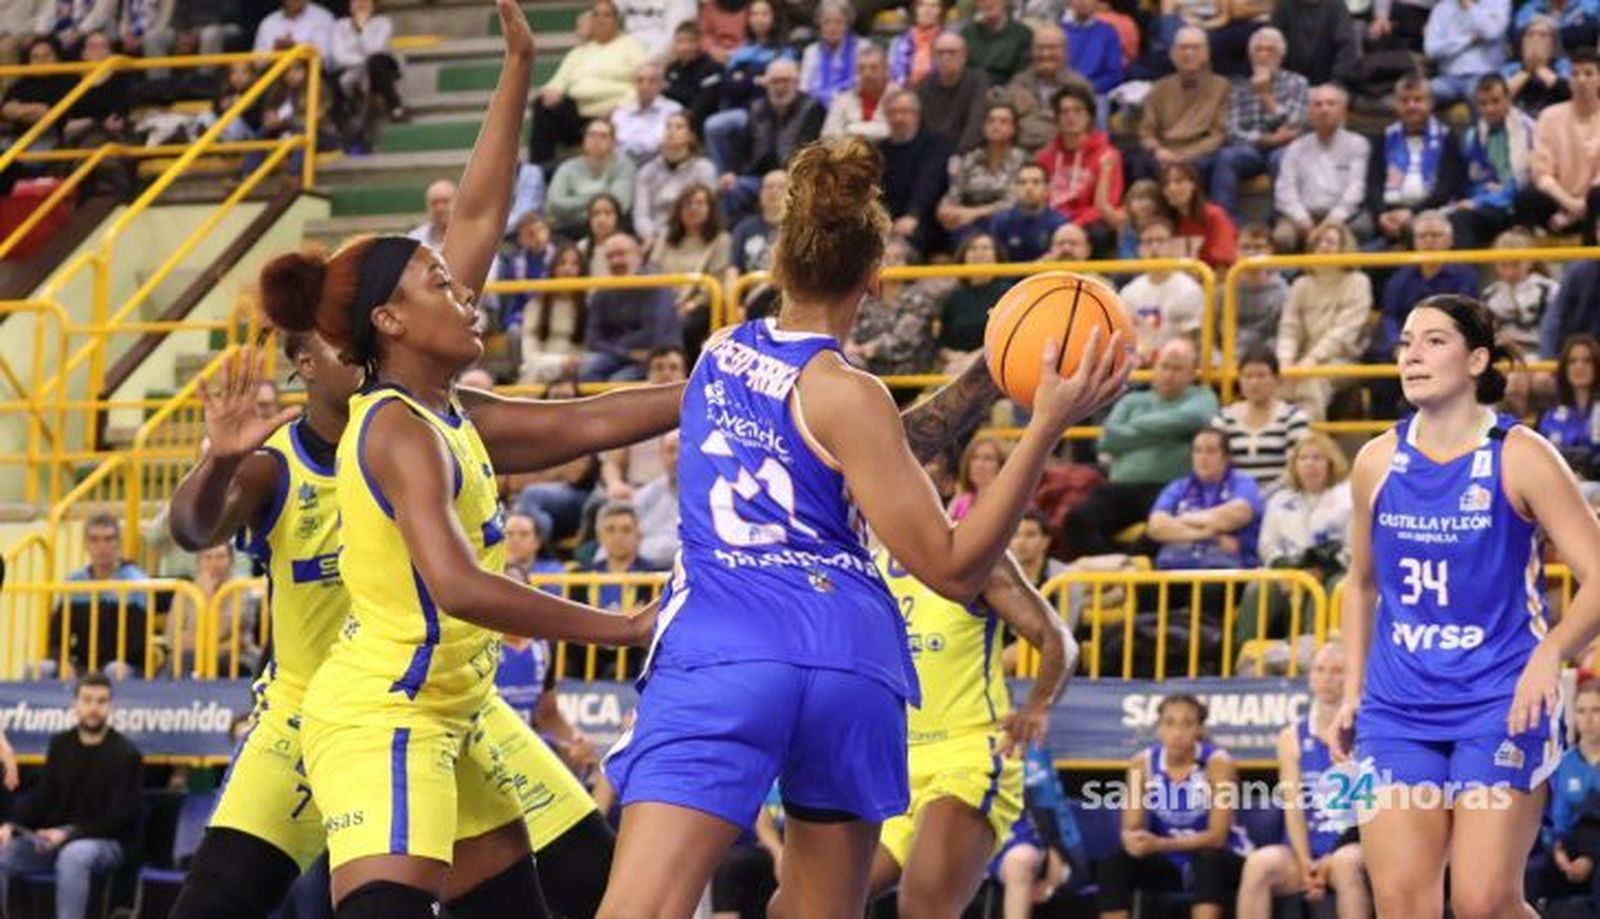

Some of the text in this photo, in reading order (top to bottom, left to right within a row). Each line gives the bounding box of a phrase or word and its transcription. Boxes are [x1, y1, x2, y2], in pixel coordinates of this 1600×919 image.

[1379, 513, 1492, 532] CASTILLA Y LEÓN
[1399, 557, 1448, 606] 34
[293, 783, 313, 819] 7
